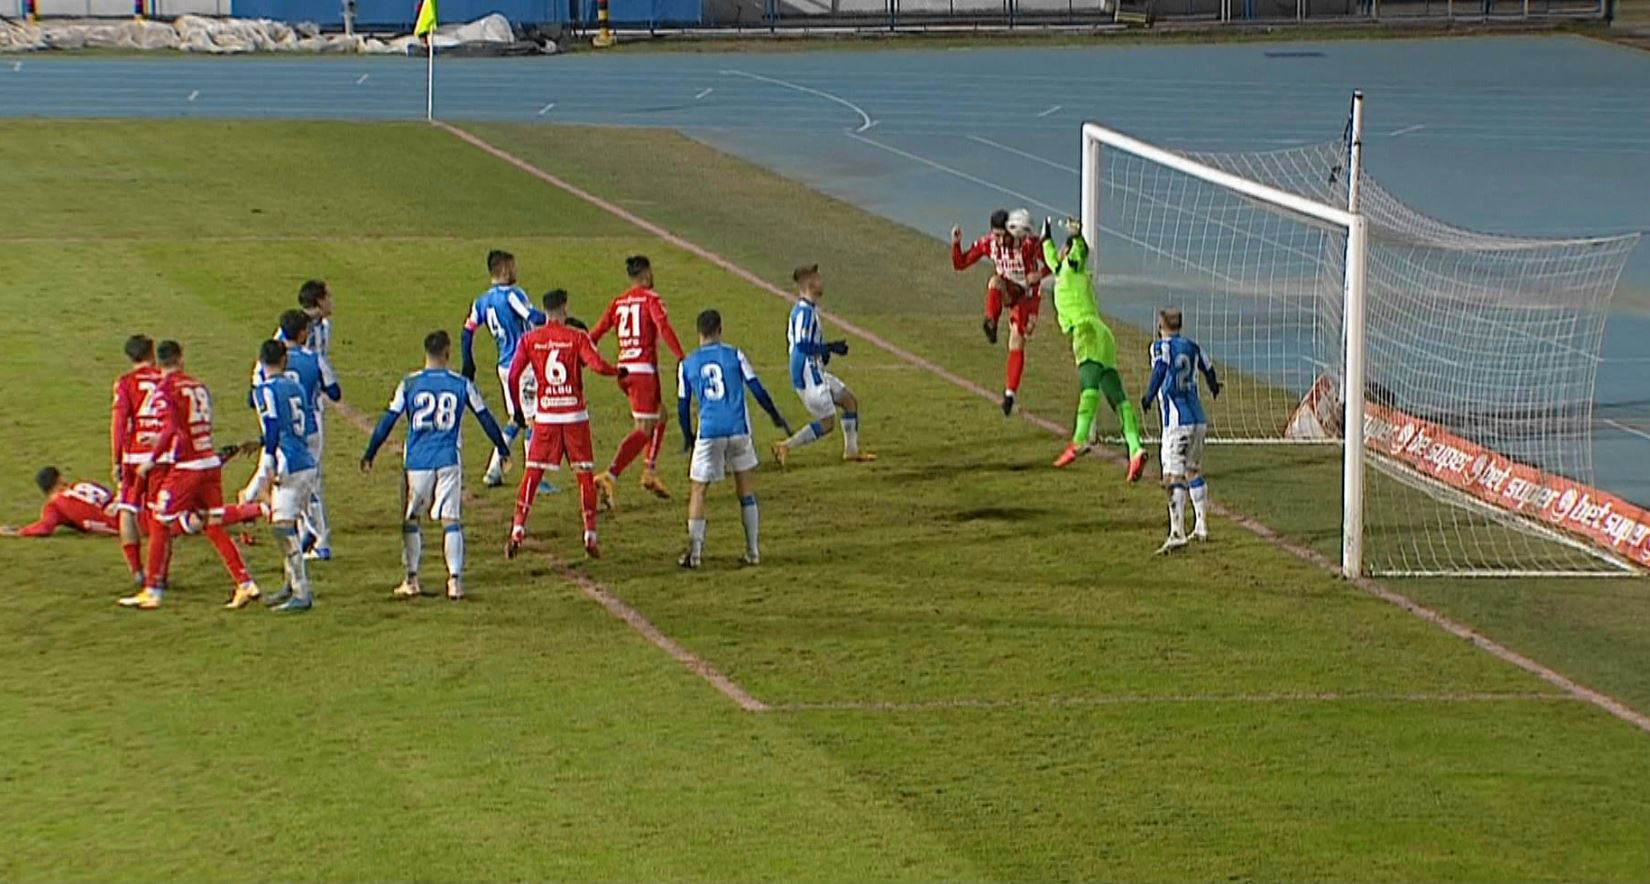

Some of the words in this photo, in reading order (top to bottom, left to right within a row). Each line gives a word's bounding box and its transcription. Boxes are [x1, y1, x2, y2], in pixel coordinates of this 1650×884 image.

[615, 303, 640, 338] 21
[545, 349, 567, 386] 6
[700, 363, 725, 401] 3
[288, 397, 306, 437] 5
[412, 391, 458, 432] 28
[1502, 476, 1561, 509] super
[1569, 494, 1613, 528] bet
